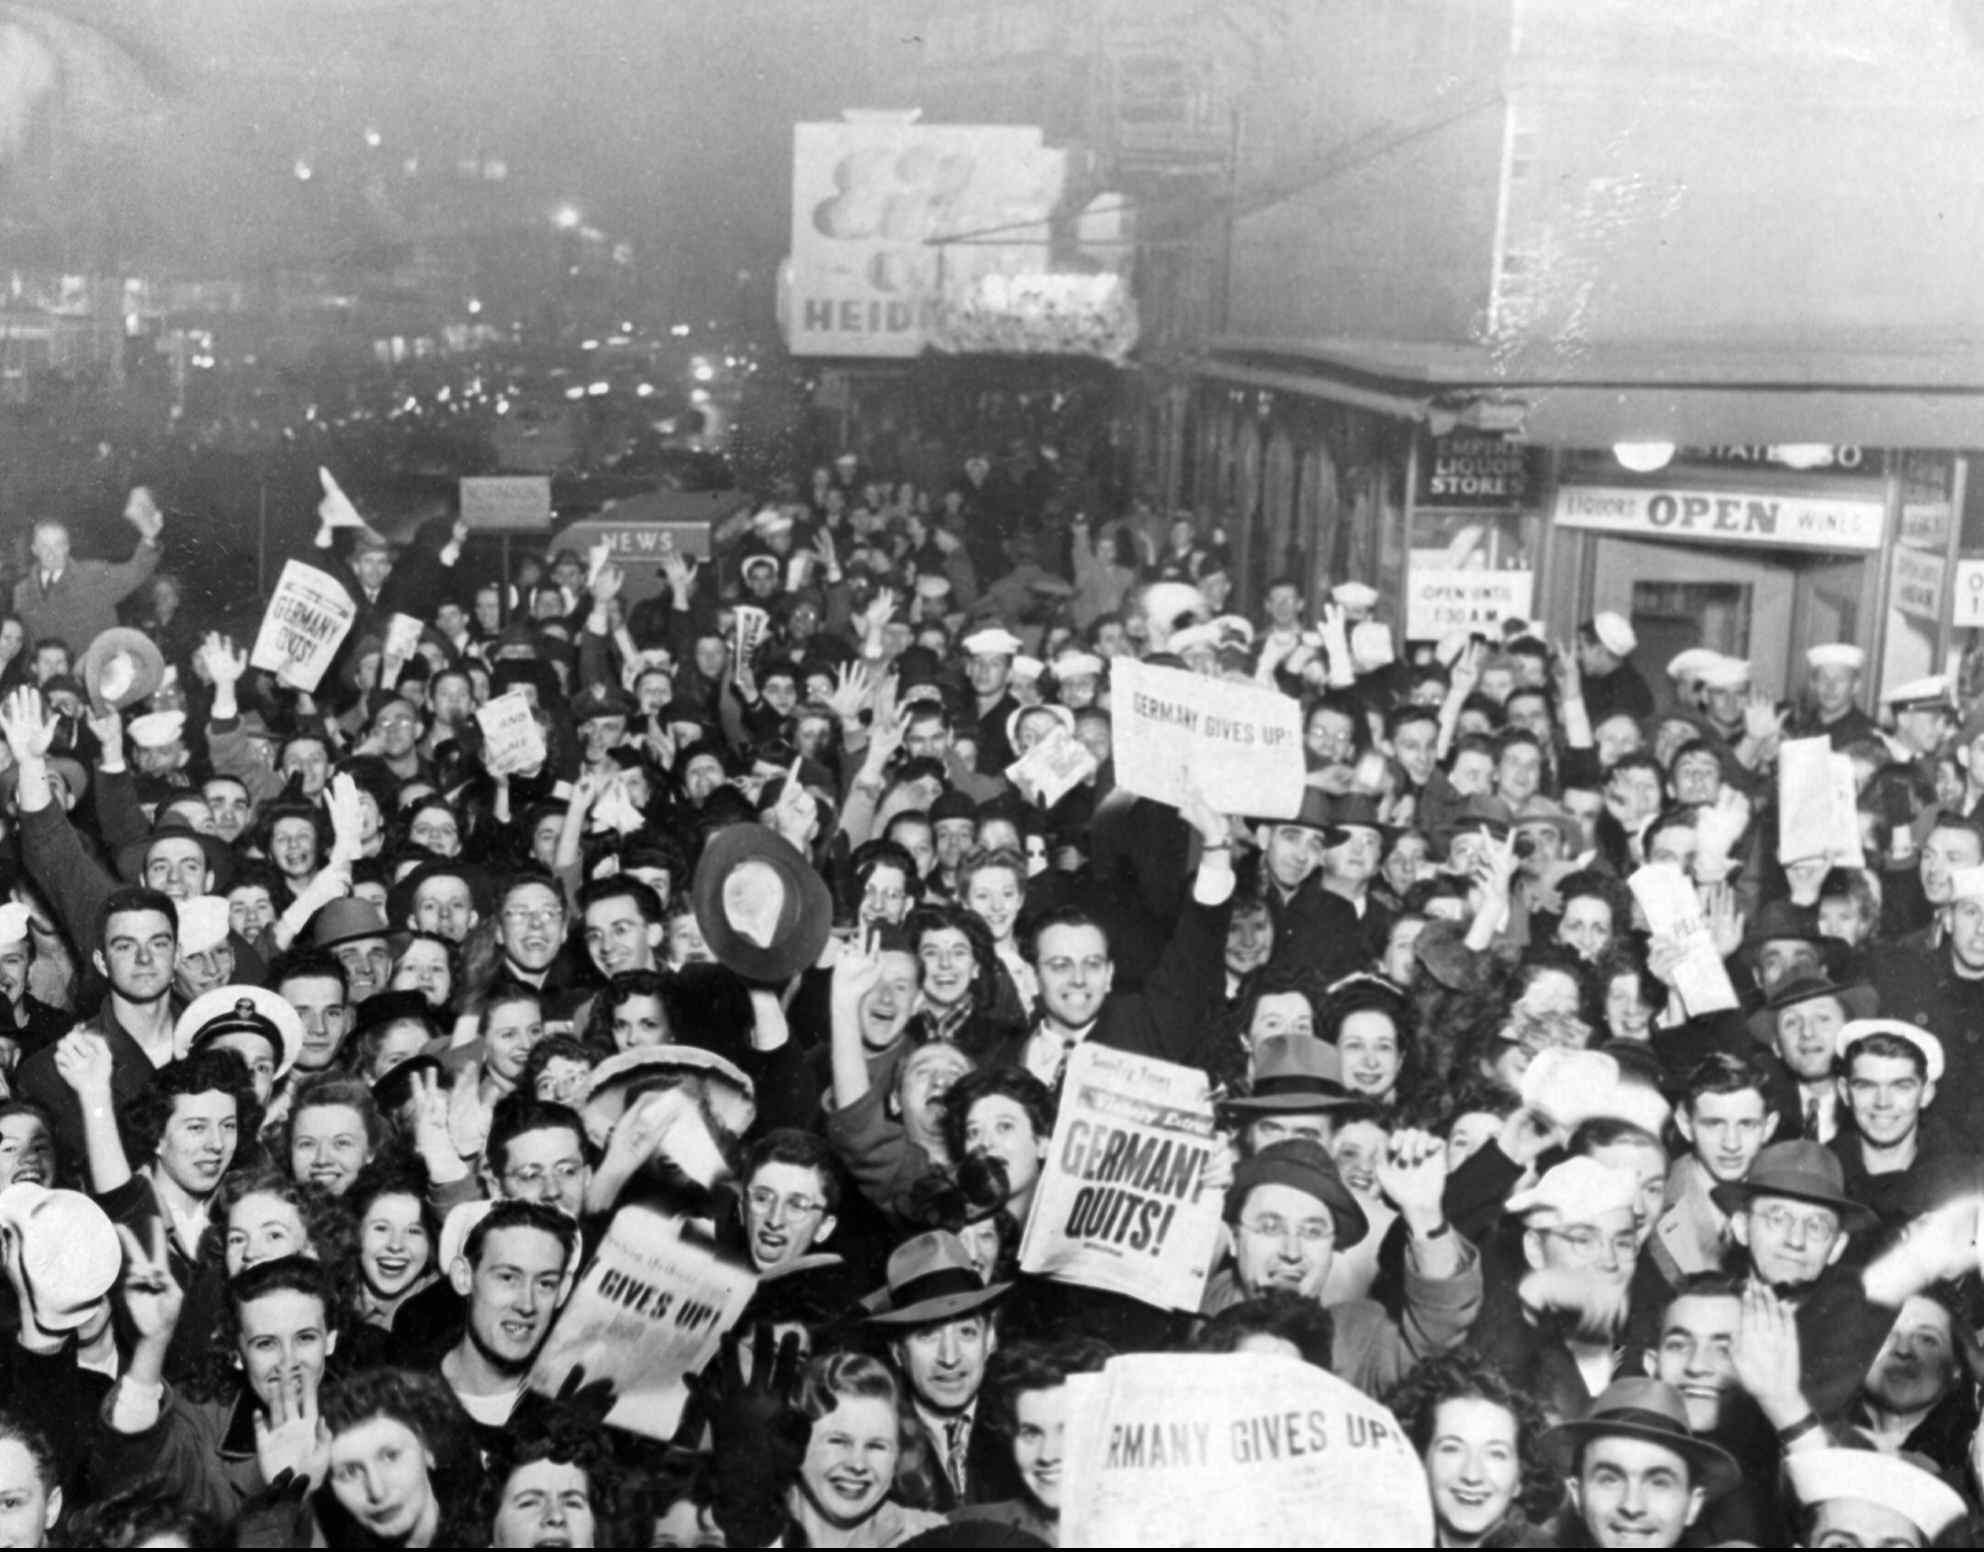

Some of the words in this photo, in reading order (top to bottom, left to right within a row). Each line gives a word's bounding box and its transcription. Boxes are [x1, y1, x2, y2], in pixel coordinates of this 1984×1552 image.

[1431, 477, 1523, 494] STORES
[1648, 493, 1780, 534] OPEN
[600, 532, 673, 552] NEWS
[1421, 585, 1465, 600] OPEN
[273, 596, 342, 645] GERMANY
[1133, 691, 1199, 733] GERMANY
[1205, 715, 1255, 745] GIVES
[1065, 1187, 1176, 1257] QUITS!
[598, 1269, 674, 1320] GIVES
[1229, 1410, 1328, 1464] GIVES
